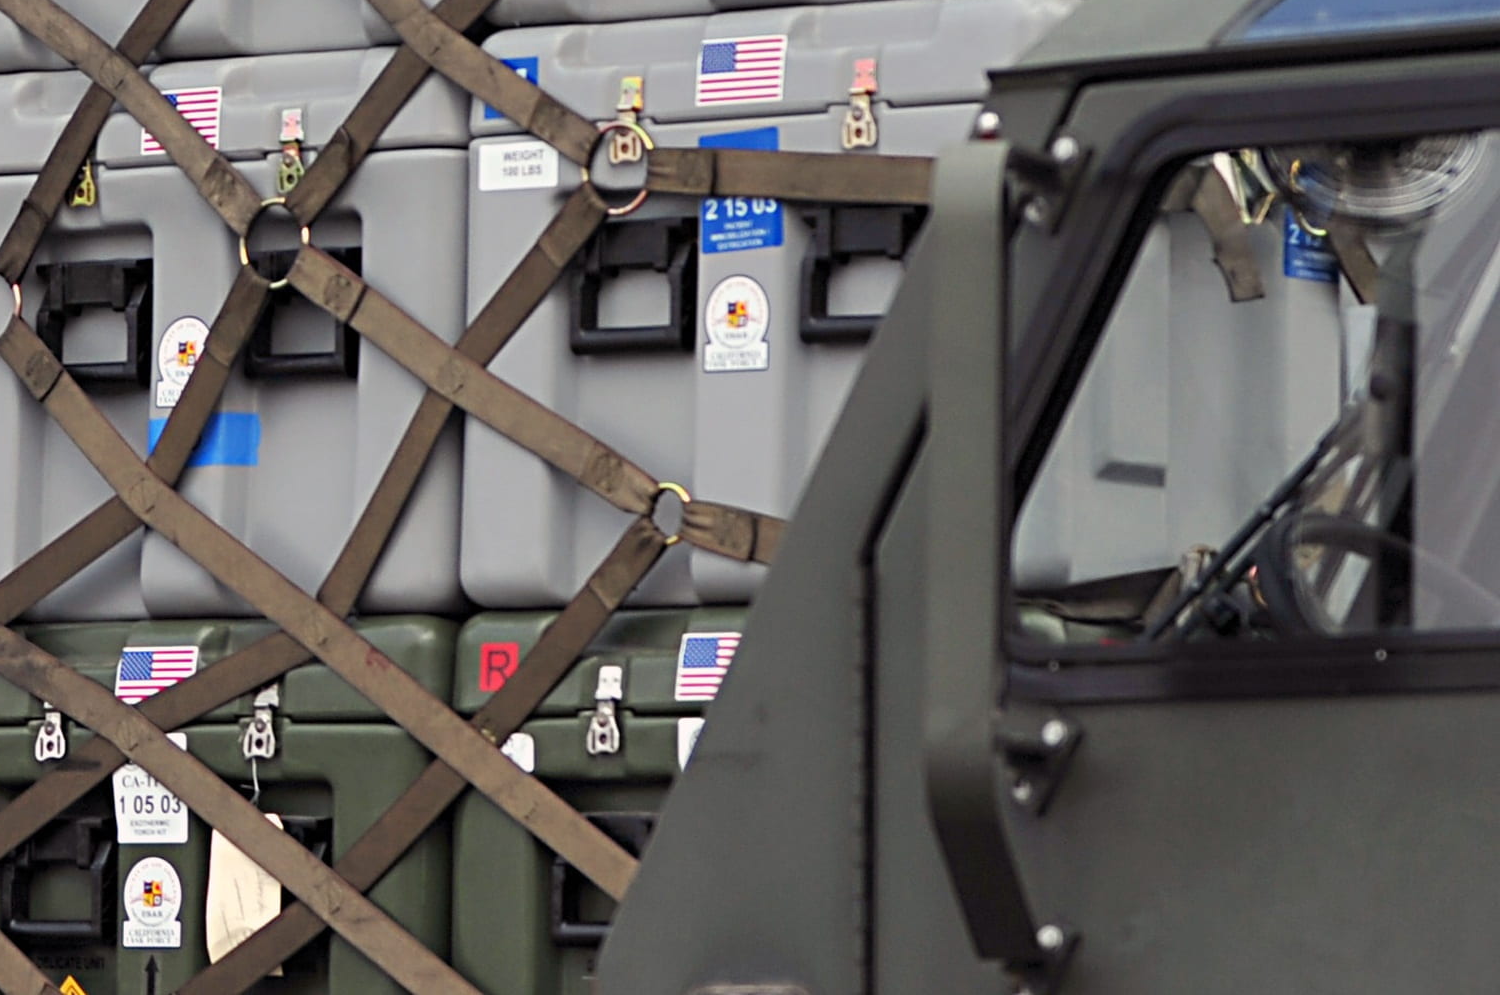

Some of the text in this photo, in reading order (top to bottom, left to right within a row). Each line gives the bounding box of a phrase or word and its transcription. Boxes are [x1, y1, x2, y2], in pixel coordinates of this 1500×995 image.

[503, 149, 544, 162] WEIGHT
[521, 164, 542, 175] LBS
[705, 199, 718, 220] 2
[724, 198, 748, 218] 15
[487, 651, 510, 688] R
[120, 794, 181, 814] 1 05 03
